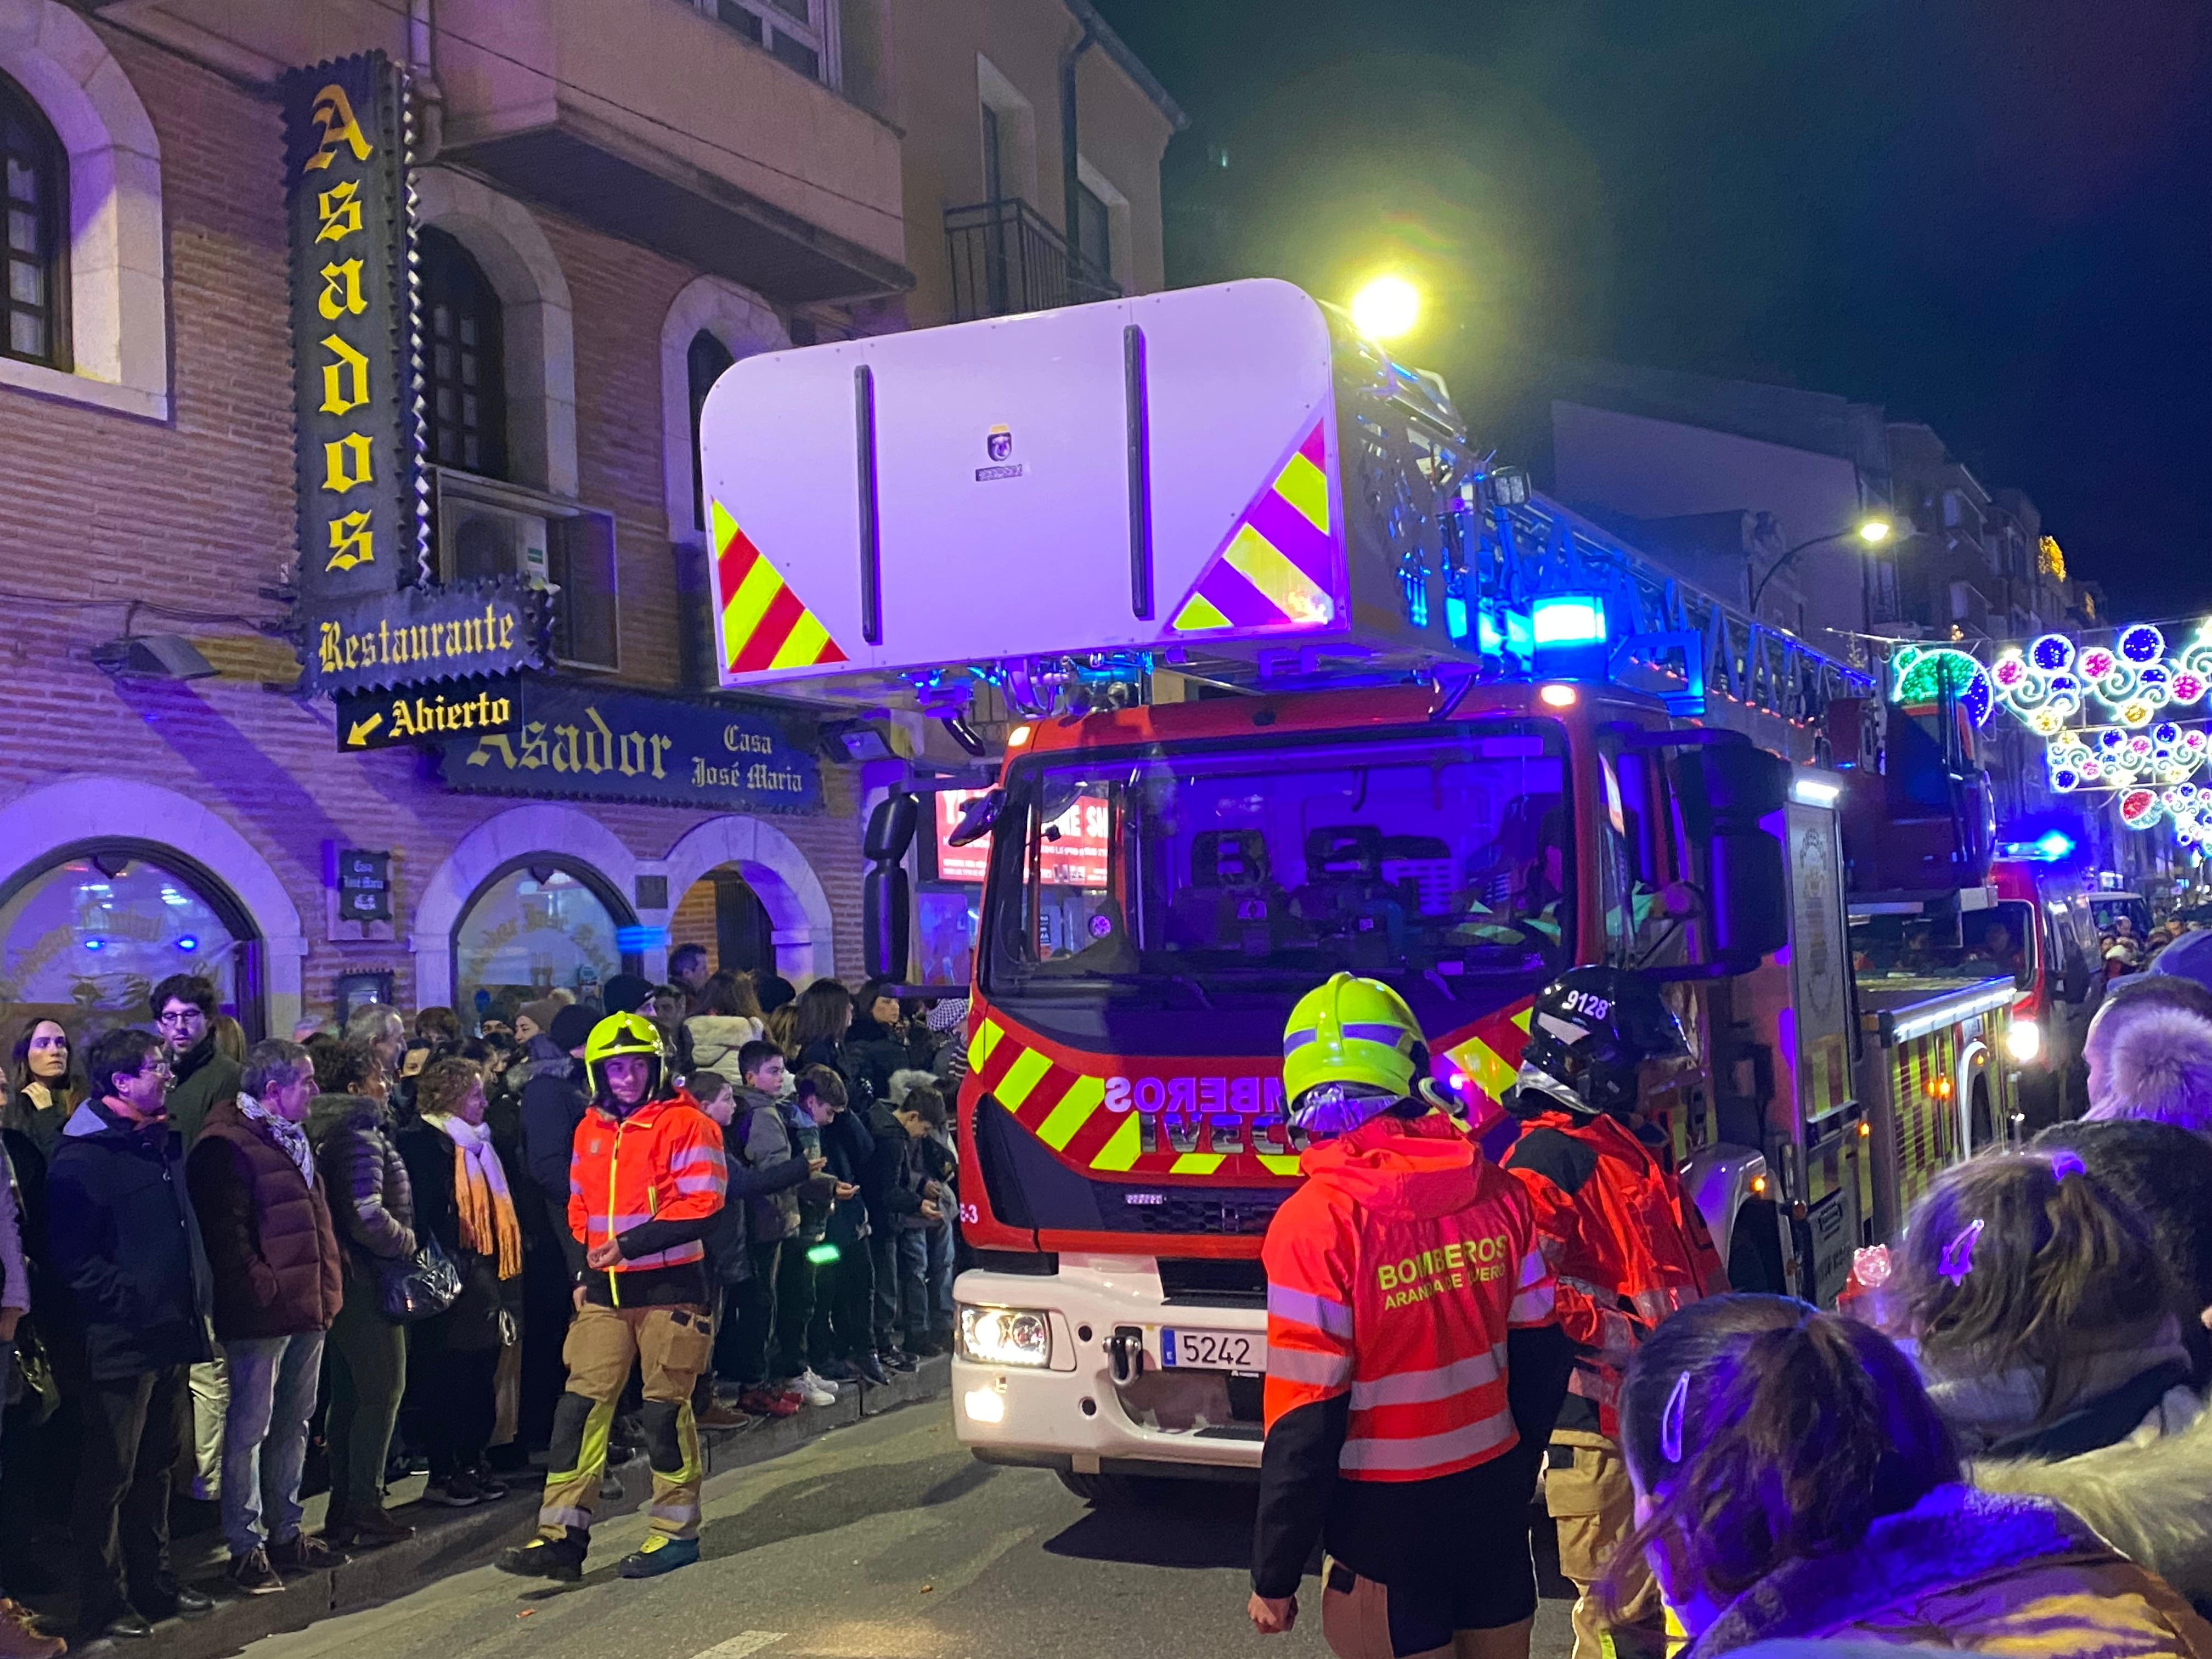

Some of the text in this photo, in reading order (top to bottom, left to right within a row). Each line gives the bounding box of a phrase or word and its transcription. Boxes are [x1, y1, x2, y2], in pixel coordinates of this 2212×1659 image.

[303, 83, 374, 572] Asados
[318, 603, 515, 673] Restaurante
[389, 691, 510, 738] Abierto
[724, 724, 772, 754] Casa
[691, 757, 740, 787] José
[1562, 990, 1609, 1019] 9128
[1378, 1235, 1508, 1290] BOMBEROS
[1183, 1335, 1251, 1366] 5242
